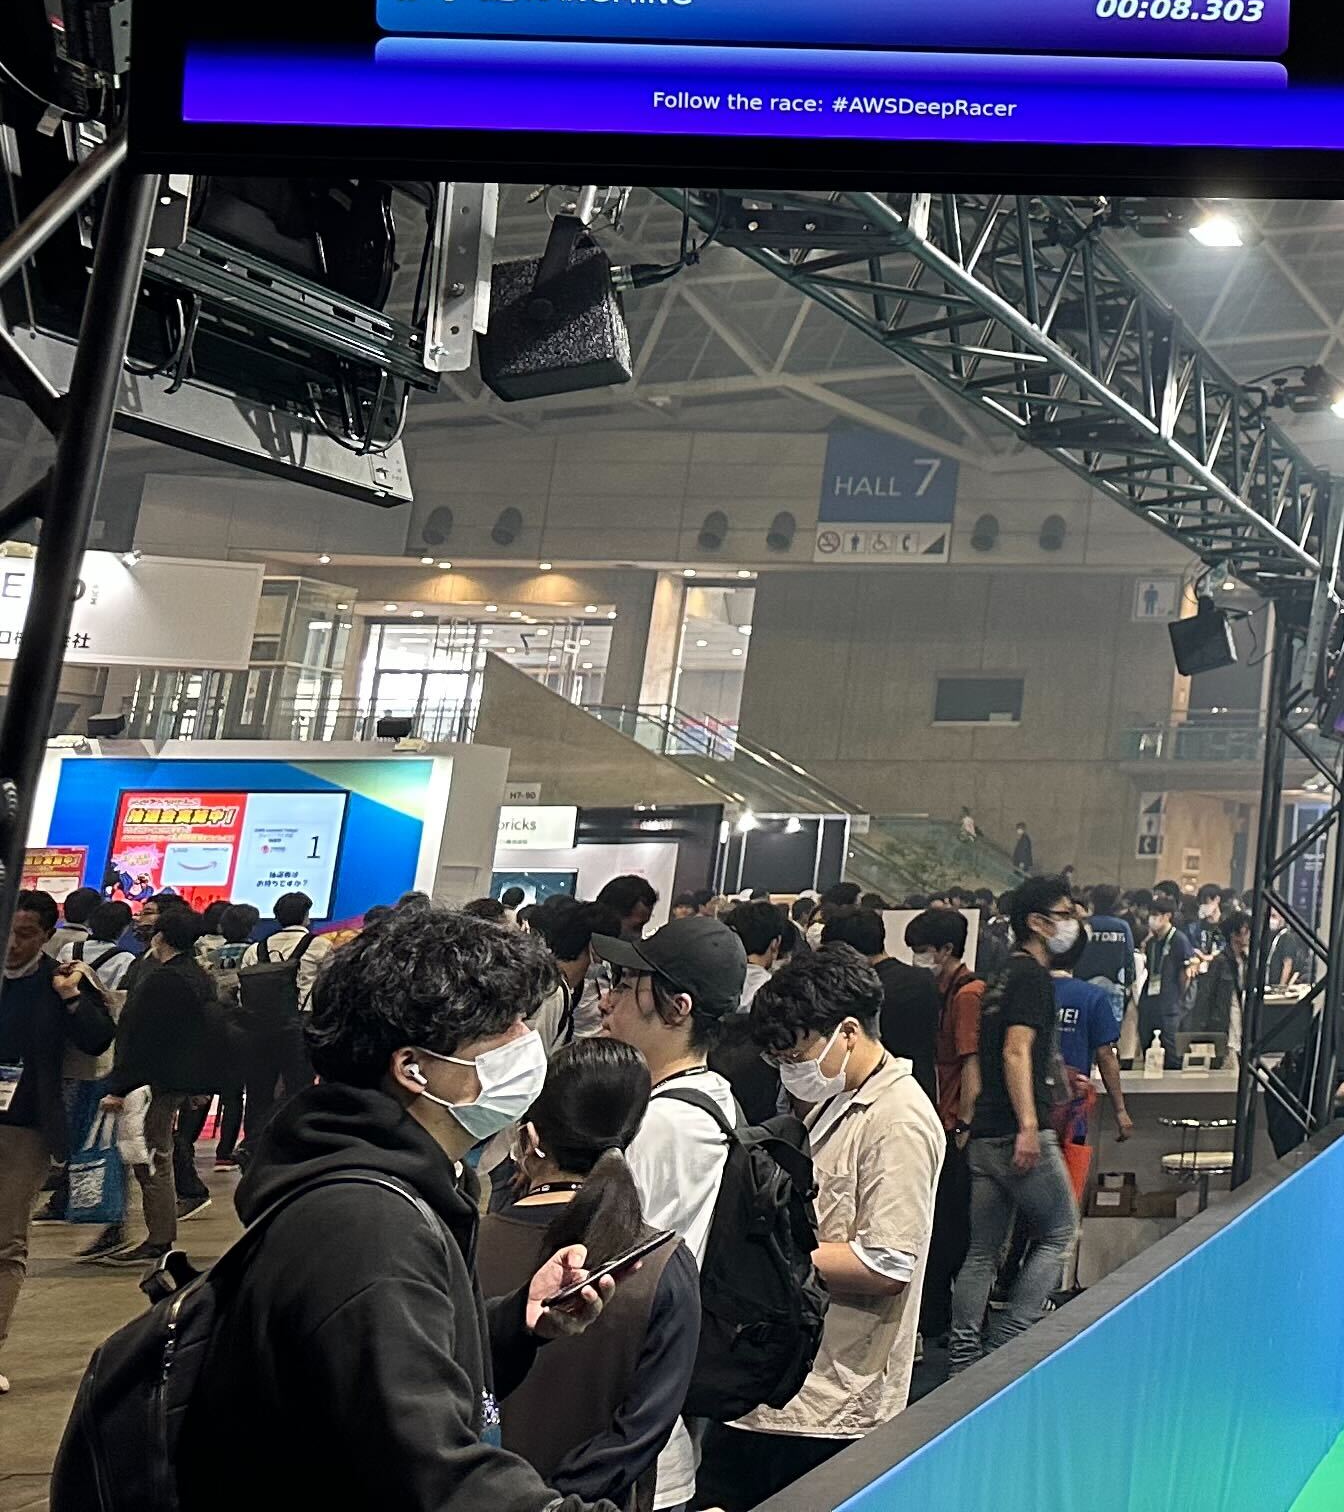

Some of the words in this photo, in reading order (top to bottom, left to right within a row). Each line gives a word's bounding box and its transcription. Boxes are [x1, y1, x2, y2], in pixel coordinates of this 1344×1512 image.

[652, 90, 720, 111] Follow
[726, 92, 764, 112] the
[769, 97, 823, 114] race:
[831, 95, 1018, 119] #AWSDeepRacer
[834, 475, 901, 497] HALL
[913, 458, 942, 497] 7
